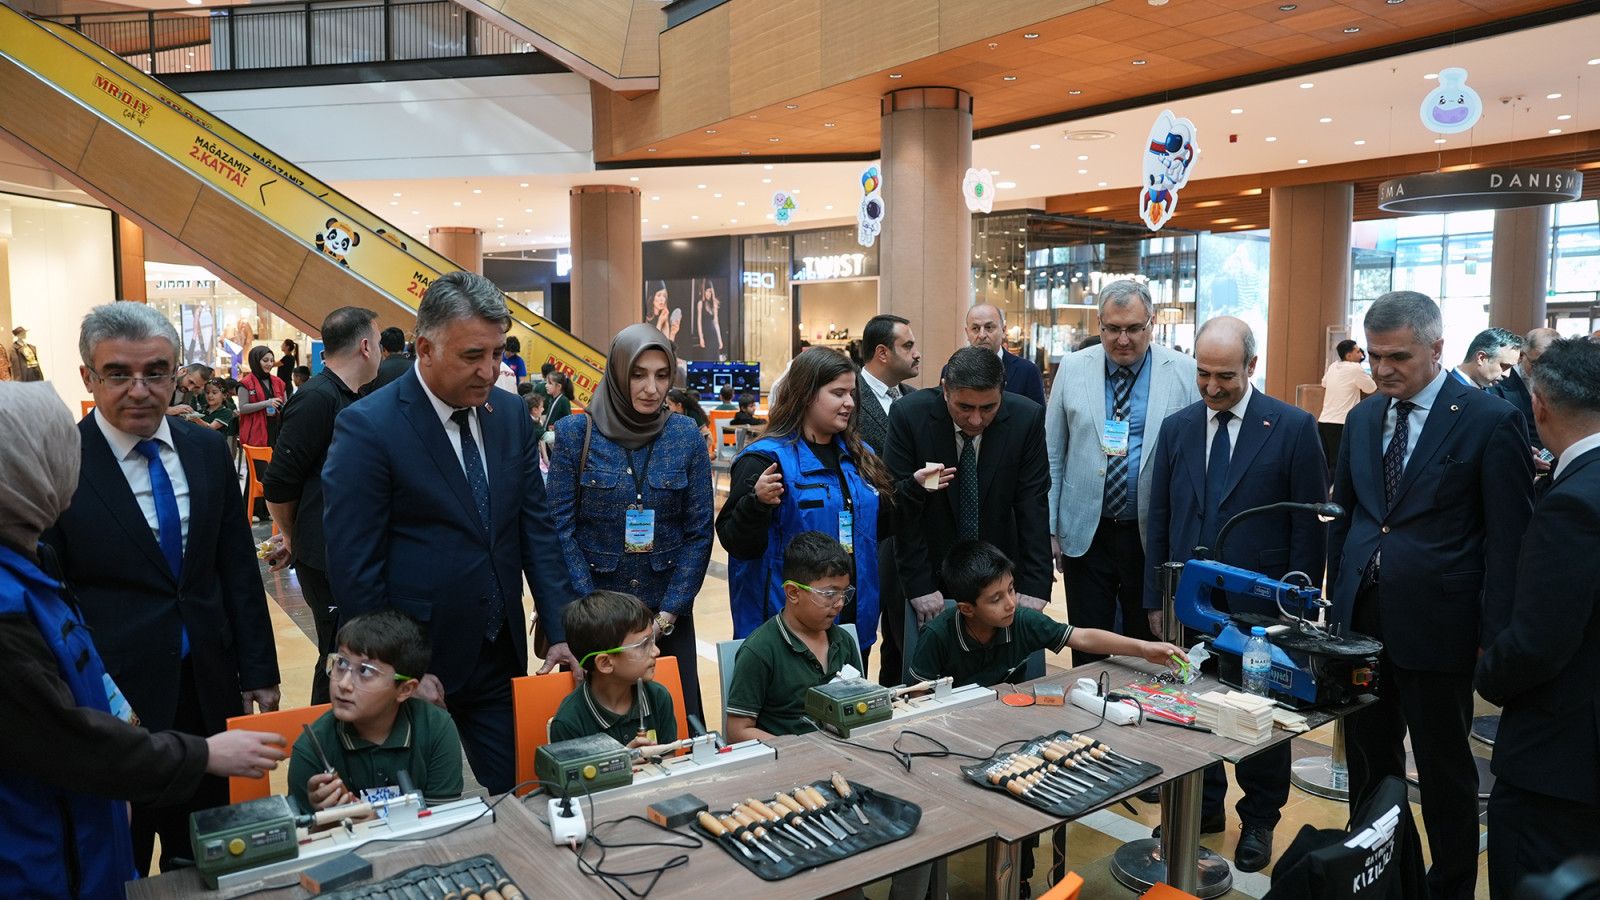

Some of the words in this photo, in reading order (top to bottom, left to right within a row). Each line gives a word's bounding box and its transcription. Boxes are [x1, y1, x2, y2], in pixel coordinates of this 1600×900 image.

[188, 145, 247, 188] 2.KATTA!
[194, 136, 251, 176] MAĞAZAMIZ
[802, 253, 864, 278] TWIST
